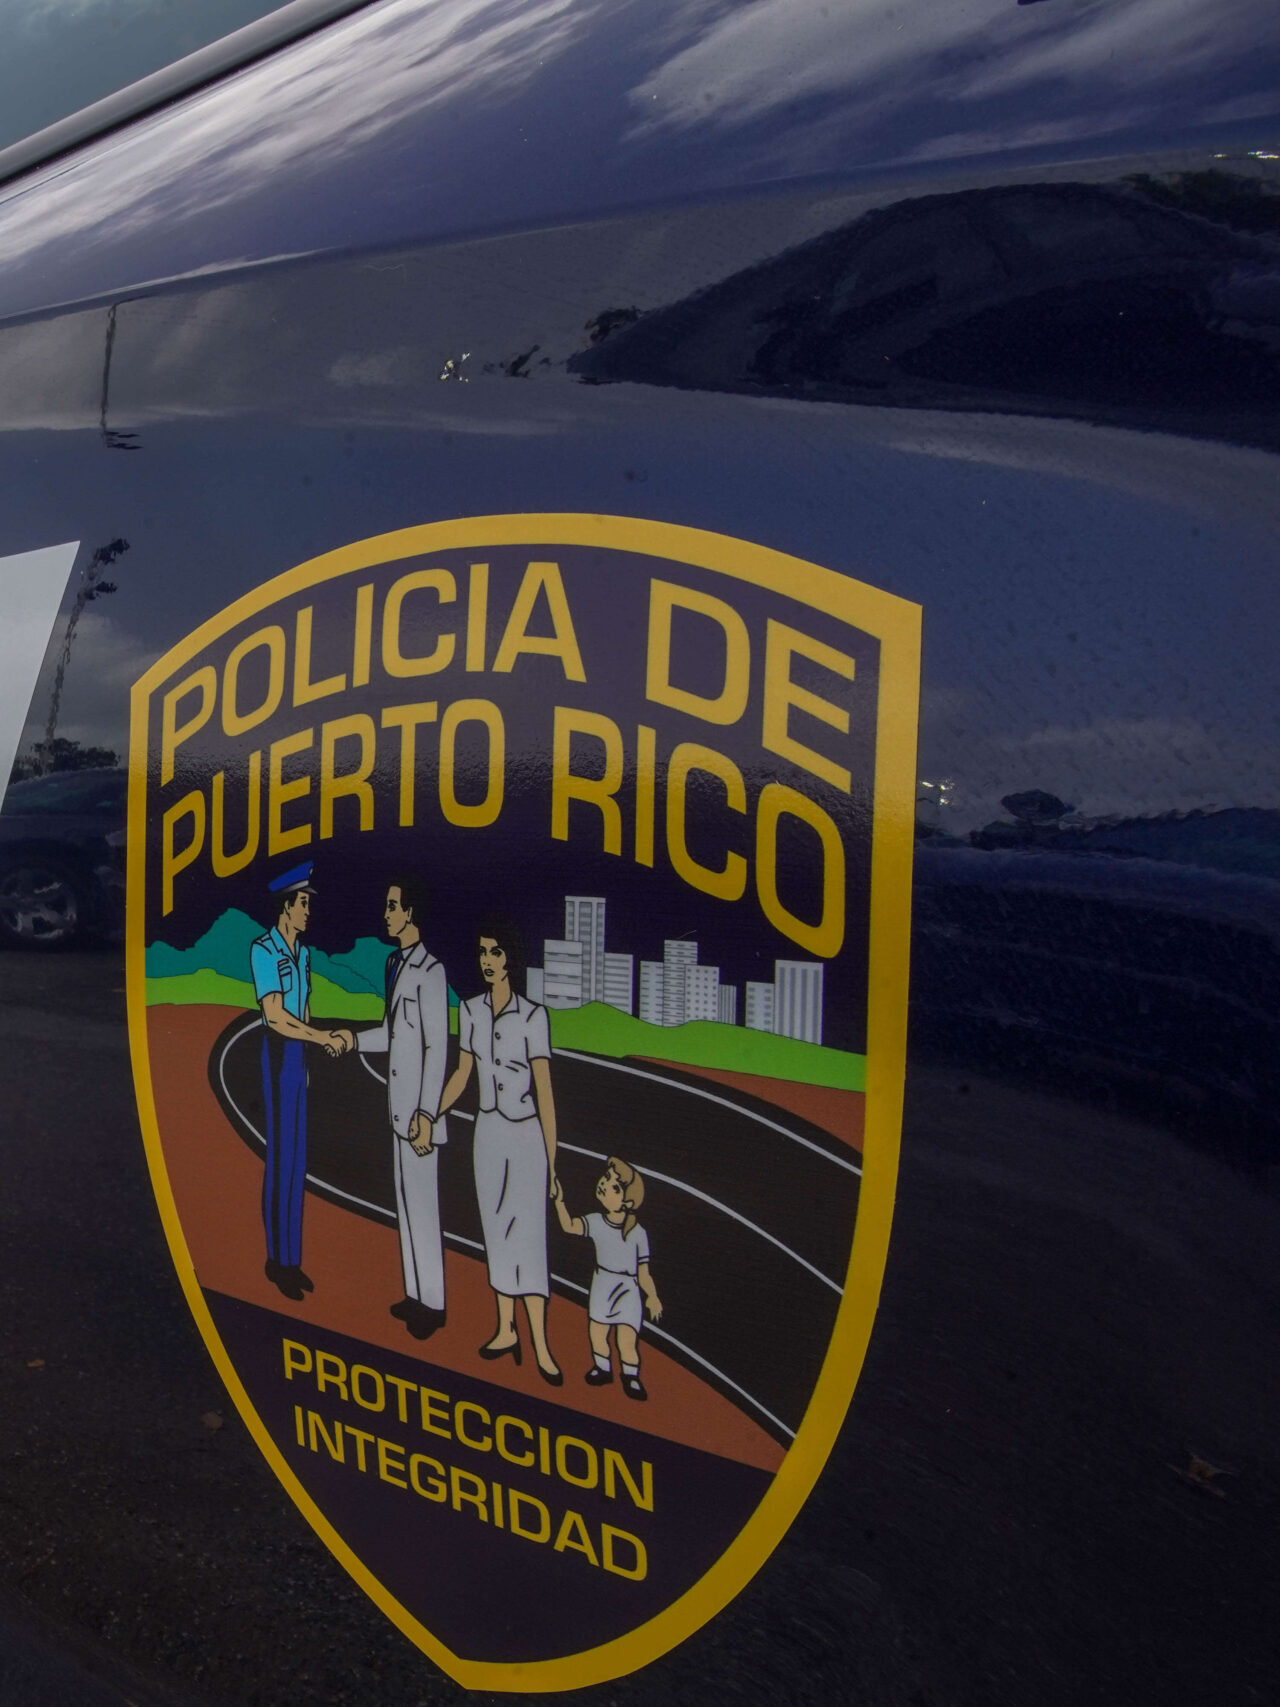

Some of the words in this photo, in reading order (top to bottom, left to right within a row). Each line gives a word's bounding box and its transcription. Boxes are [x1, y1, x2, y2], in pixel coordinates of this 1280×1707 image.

[161, 562, 585, 787] POLICIA
[646, 579, 855, 794] DE
[163, 698, 505, 916] PUERTO
[552, 706, 845, 958] RICO
[283, 1338, 654, 1512] PROTECCION
[295, 1405, 648, 1581] INTEGRIDAD
